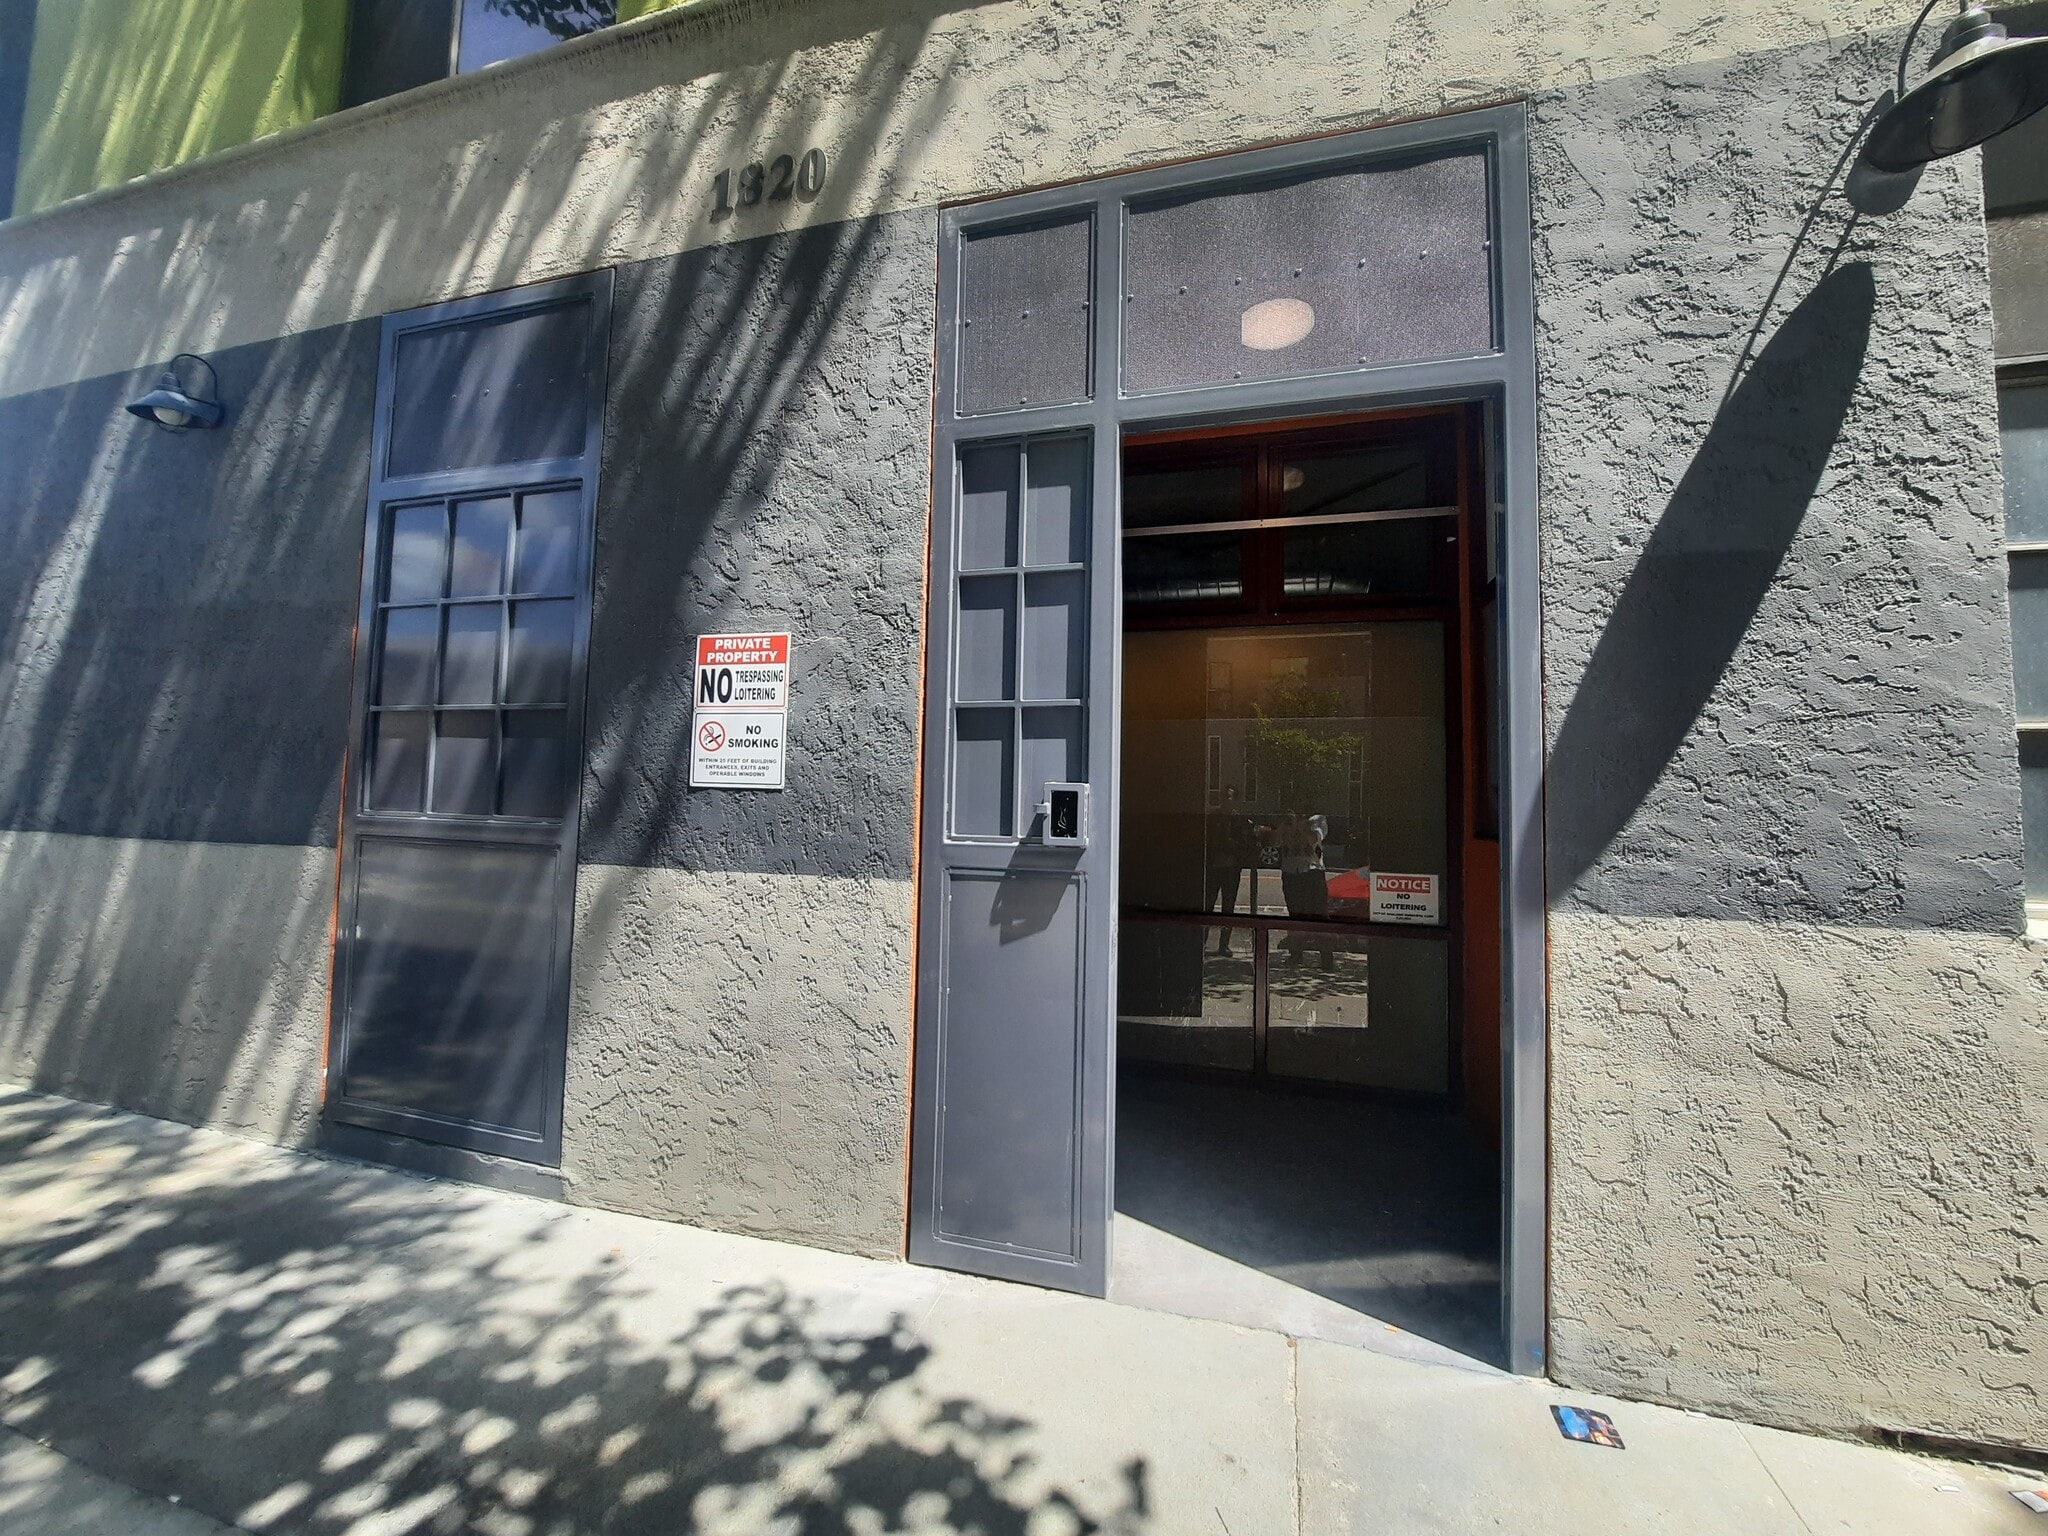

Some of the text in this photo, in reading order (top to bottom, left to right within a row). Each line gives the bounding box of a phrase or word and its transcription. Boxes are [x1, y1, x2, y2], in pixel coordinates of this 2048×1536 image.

[715, 638, 771, 650] PRIVATE
[707, 651, 778, 663] PROPERTY
[735, 670, 784, 683] TRESPASSING
[700, 668, 733, 703] NO
[734, 688, 776, 700] LOITERING
[746, 725, 761, 735] NO
[728, 738, 779, 748] SMOKING
[1377, 878, 1430, 890] NOTICE
[1381, 903, 1427, 911] LOITERING
